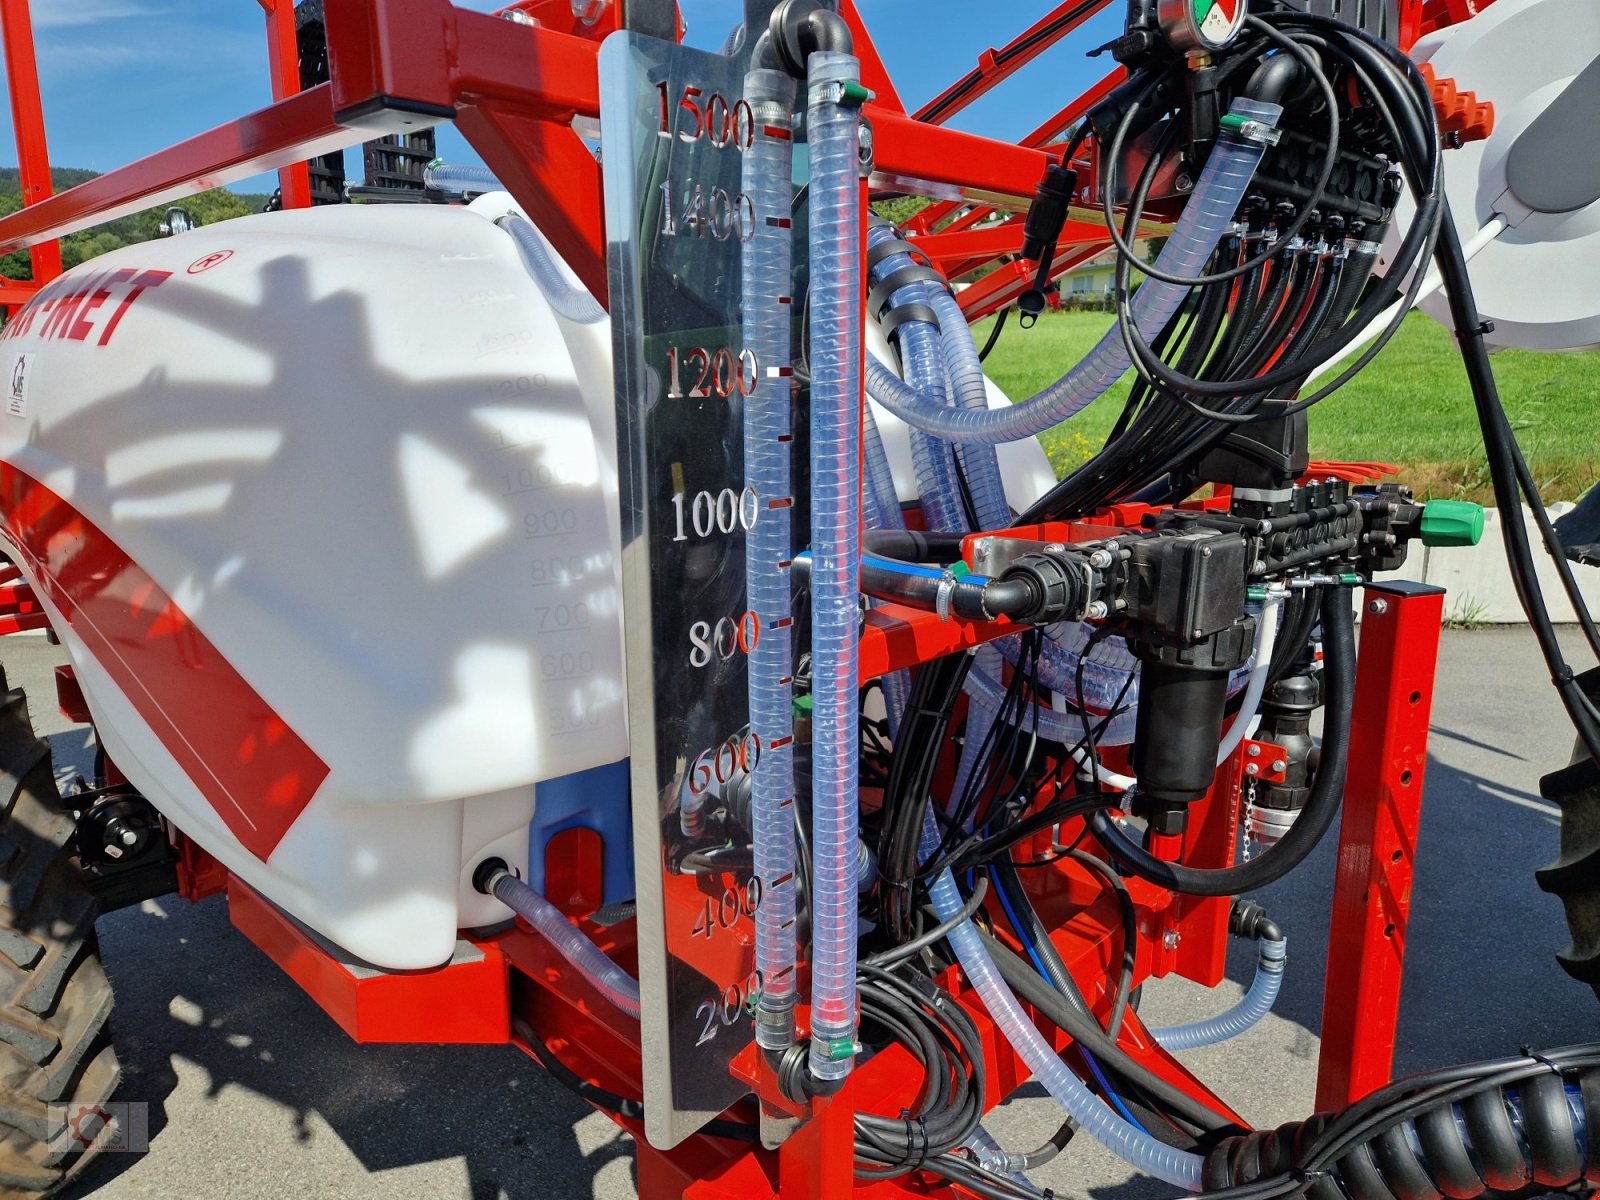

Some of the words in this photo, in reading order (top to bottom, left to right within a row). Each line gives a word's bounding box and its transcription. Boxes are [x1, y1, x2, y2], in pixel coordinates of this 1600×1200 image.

[656, 81, 755, 152] 1500
[659, 177, 756, 243] 1400
[485, 372, 548, 400] 1200
[666, 346, 759, 399] 1200
[523, 508, 578, 535] 900
[671, 486, 759, 541] 1000
[530, 554, 585, 582] 800
[533, 602, 590, 629] 700
[689, 609, 760, 667] 800
[540, 650, 594, 677] 600
[688, 732, 762, 795] 600
[691, 875, 763, 940] 400
[695, 970, 764, 1047] 200
